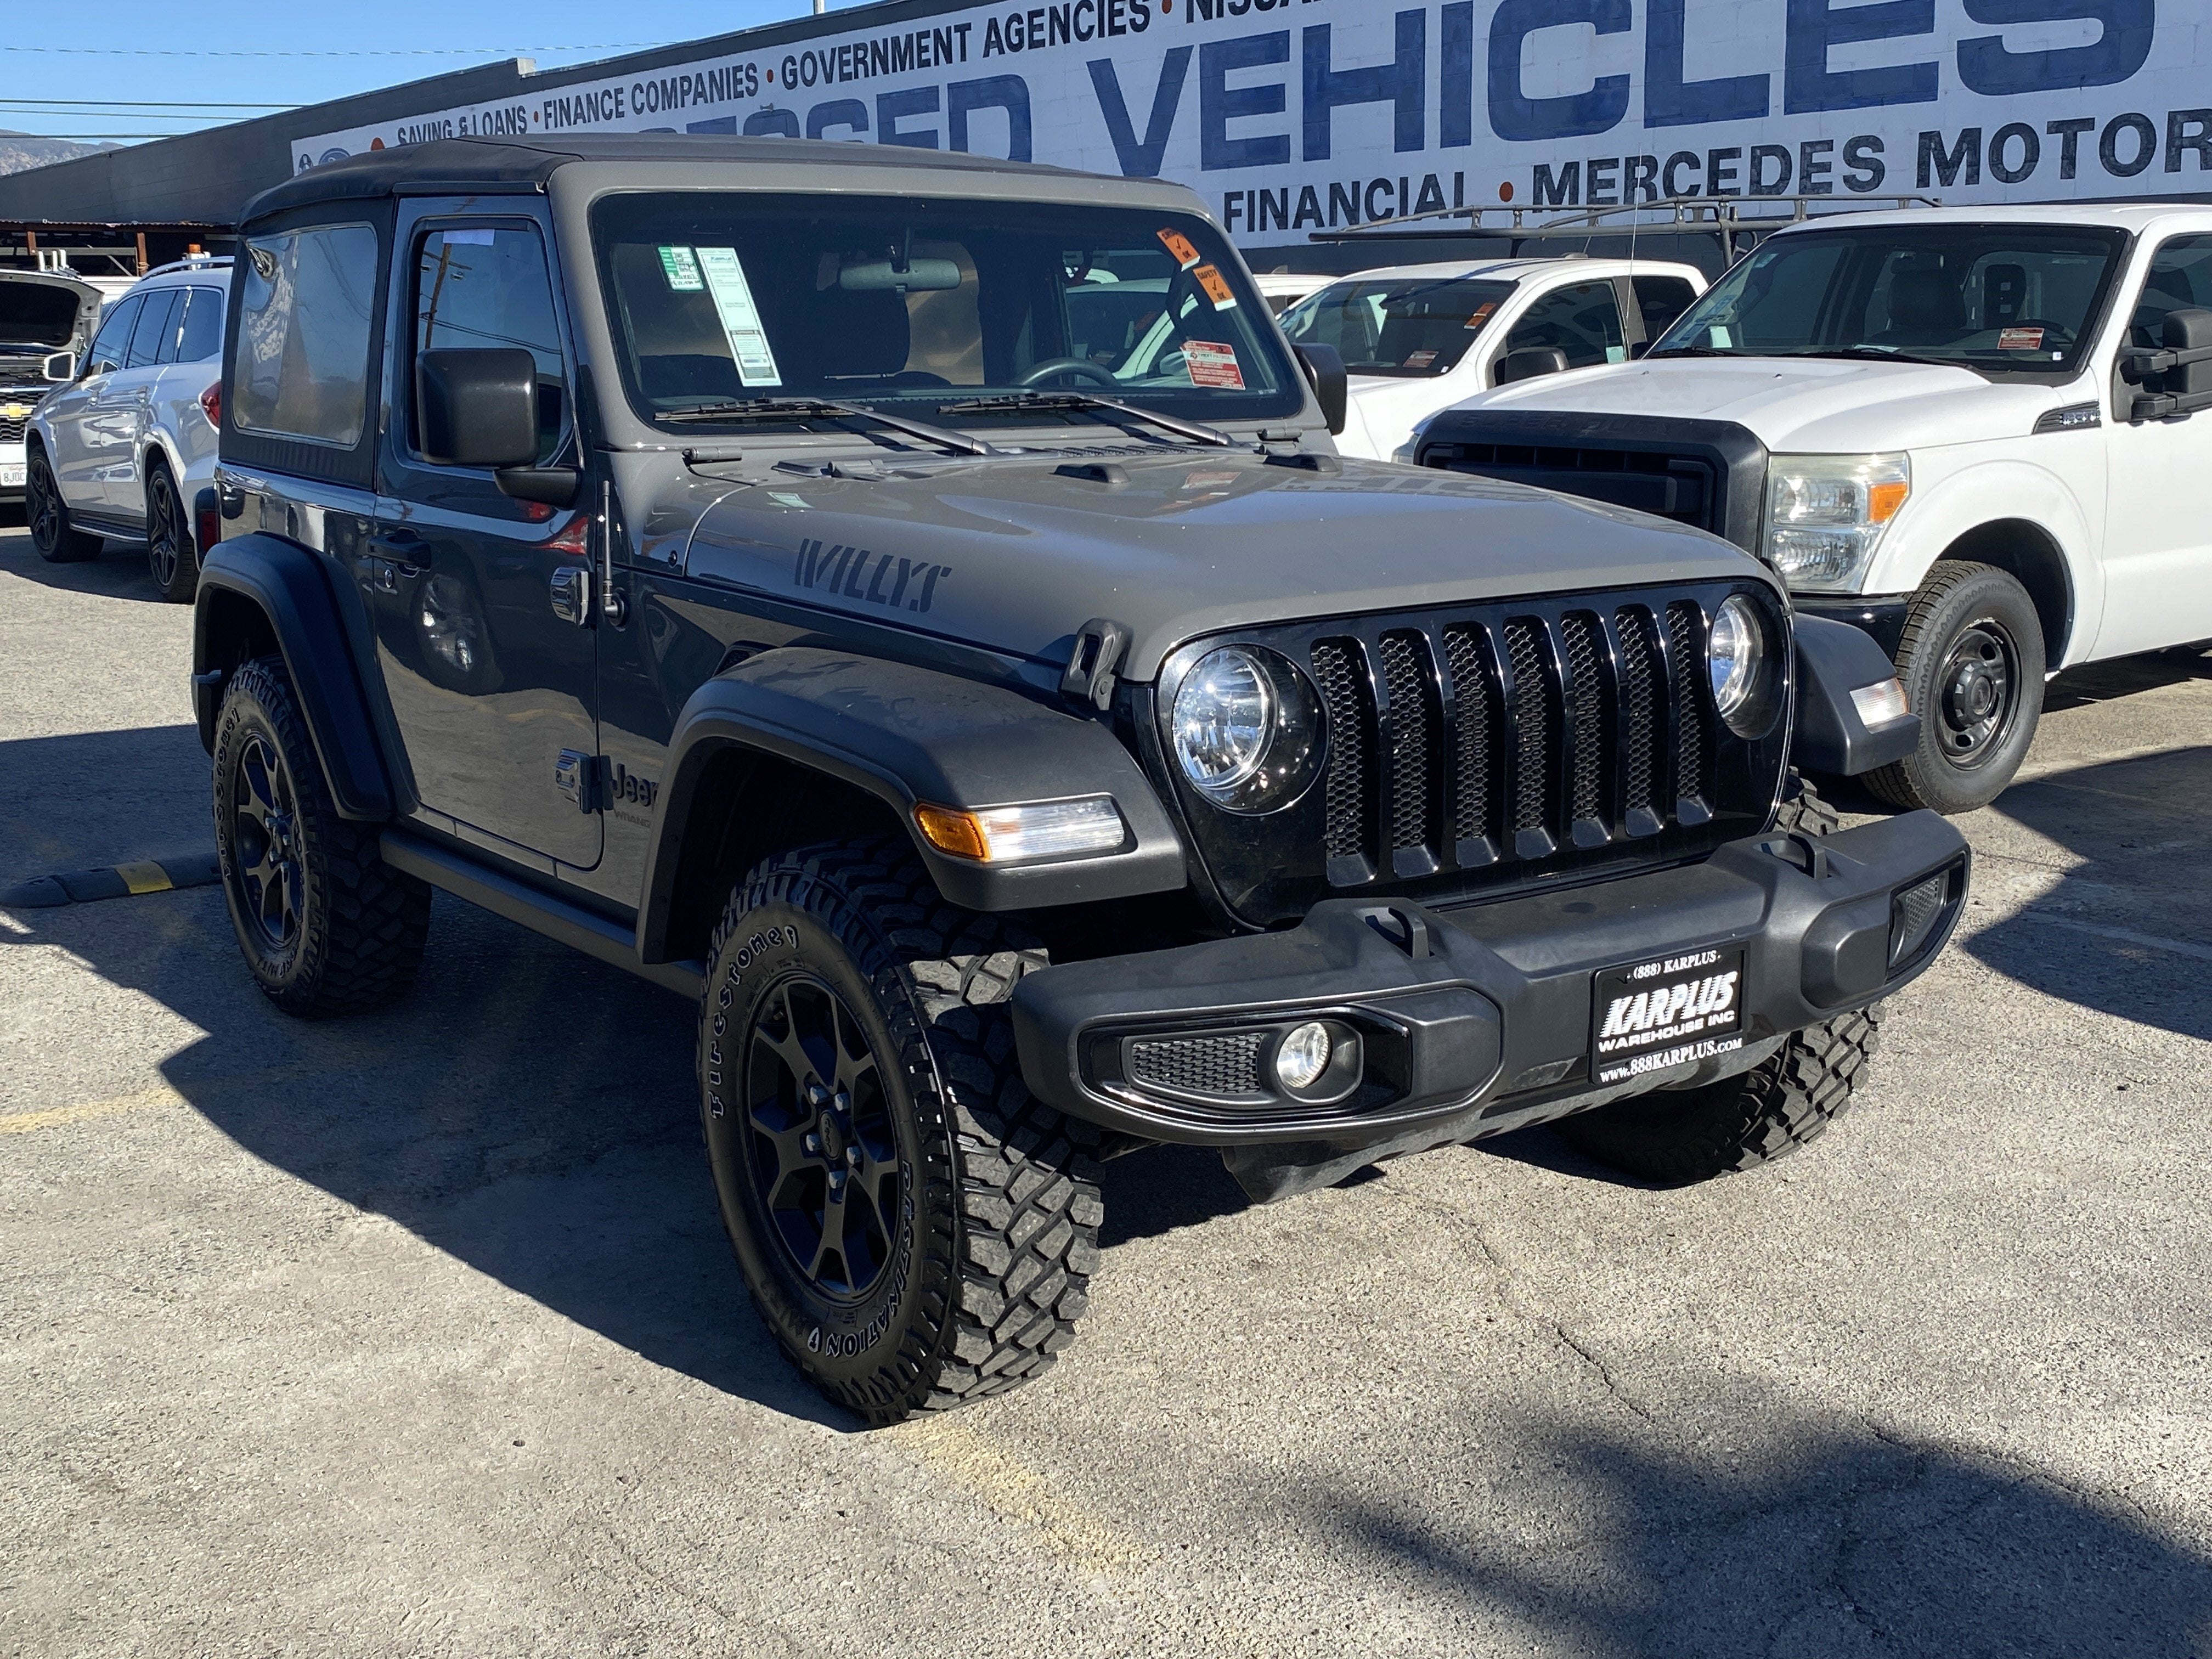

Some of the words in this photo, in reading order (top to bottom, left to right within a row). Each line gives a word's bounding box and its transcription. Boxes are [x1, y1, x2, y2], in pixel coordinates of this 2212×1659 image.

[398, 119, 452, 144] SAVING
[459, 116, 467, 137] &
[472, 105, 527, 136] LOANS
[543, 87, 625, 130] FINANCE
[631, 62, 759, 116] COMPANIES
[781, 22, 971, 91] GOVERNMENT
[984, 0, 1150, 57] AGENCIES
[1086, 0, 2155, 177] VEHICLES
[1223, 172, 1465, 233] FINANCIAL
[1532, 134, 1886, 215] MERCEDES
[795, 538, 952, 612] WILLYS
[1599, 970, 1739, 1038] KARPLUS
[1633, 962, 1661, 979] (888)
[1663, 950, 1717, 974] KARPLUS
[709, 927, 785, 1120] Firestone
[1598, 1018, 1705, 1053] WAREHOUSE
[1707, 1009, 1735, 1026] INC
[825, 1160, 916, 1358] DESTINATION
